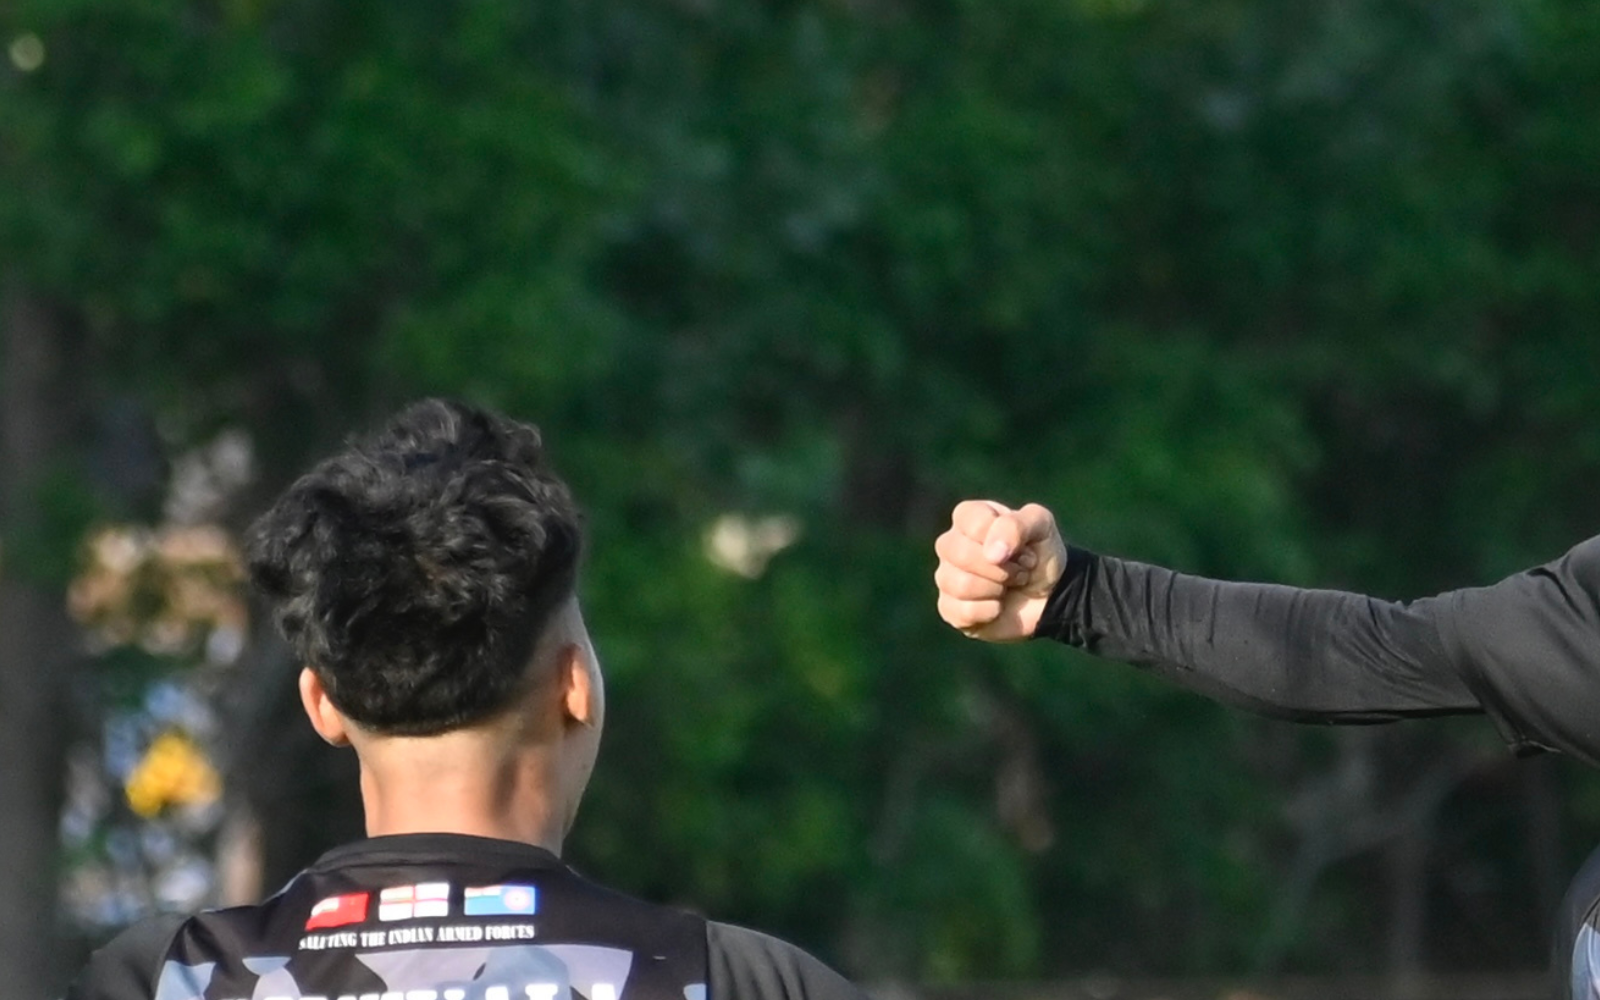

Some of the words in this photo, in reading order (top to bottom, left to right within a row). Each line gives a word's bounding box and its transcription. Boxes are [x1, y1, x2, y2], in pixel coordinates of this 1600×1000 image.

[360, 931, 386, 947] THE
[388, 927, 434, 945] INDIAN
[436, 925, 483, 942] ARMED
[485, 924, 535, 940] FORCES
